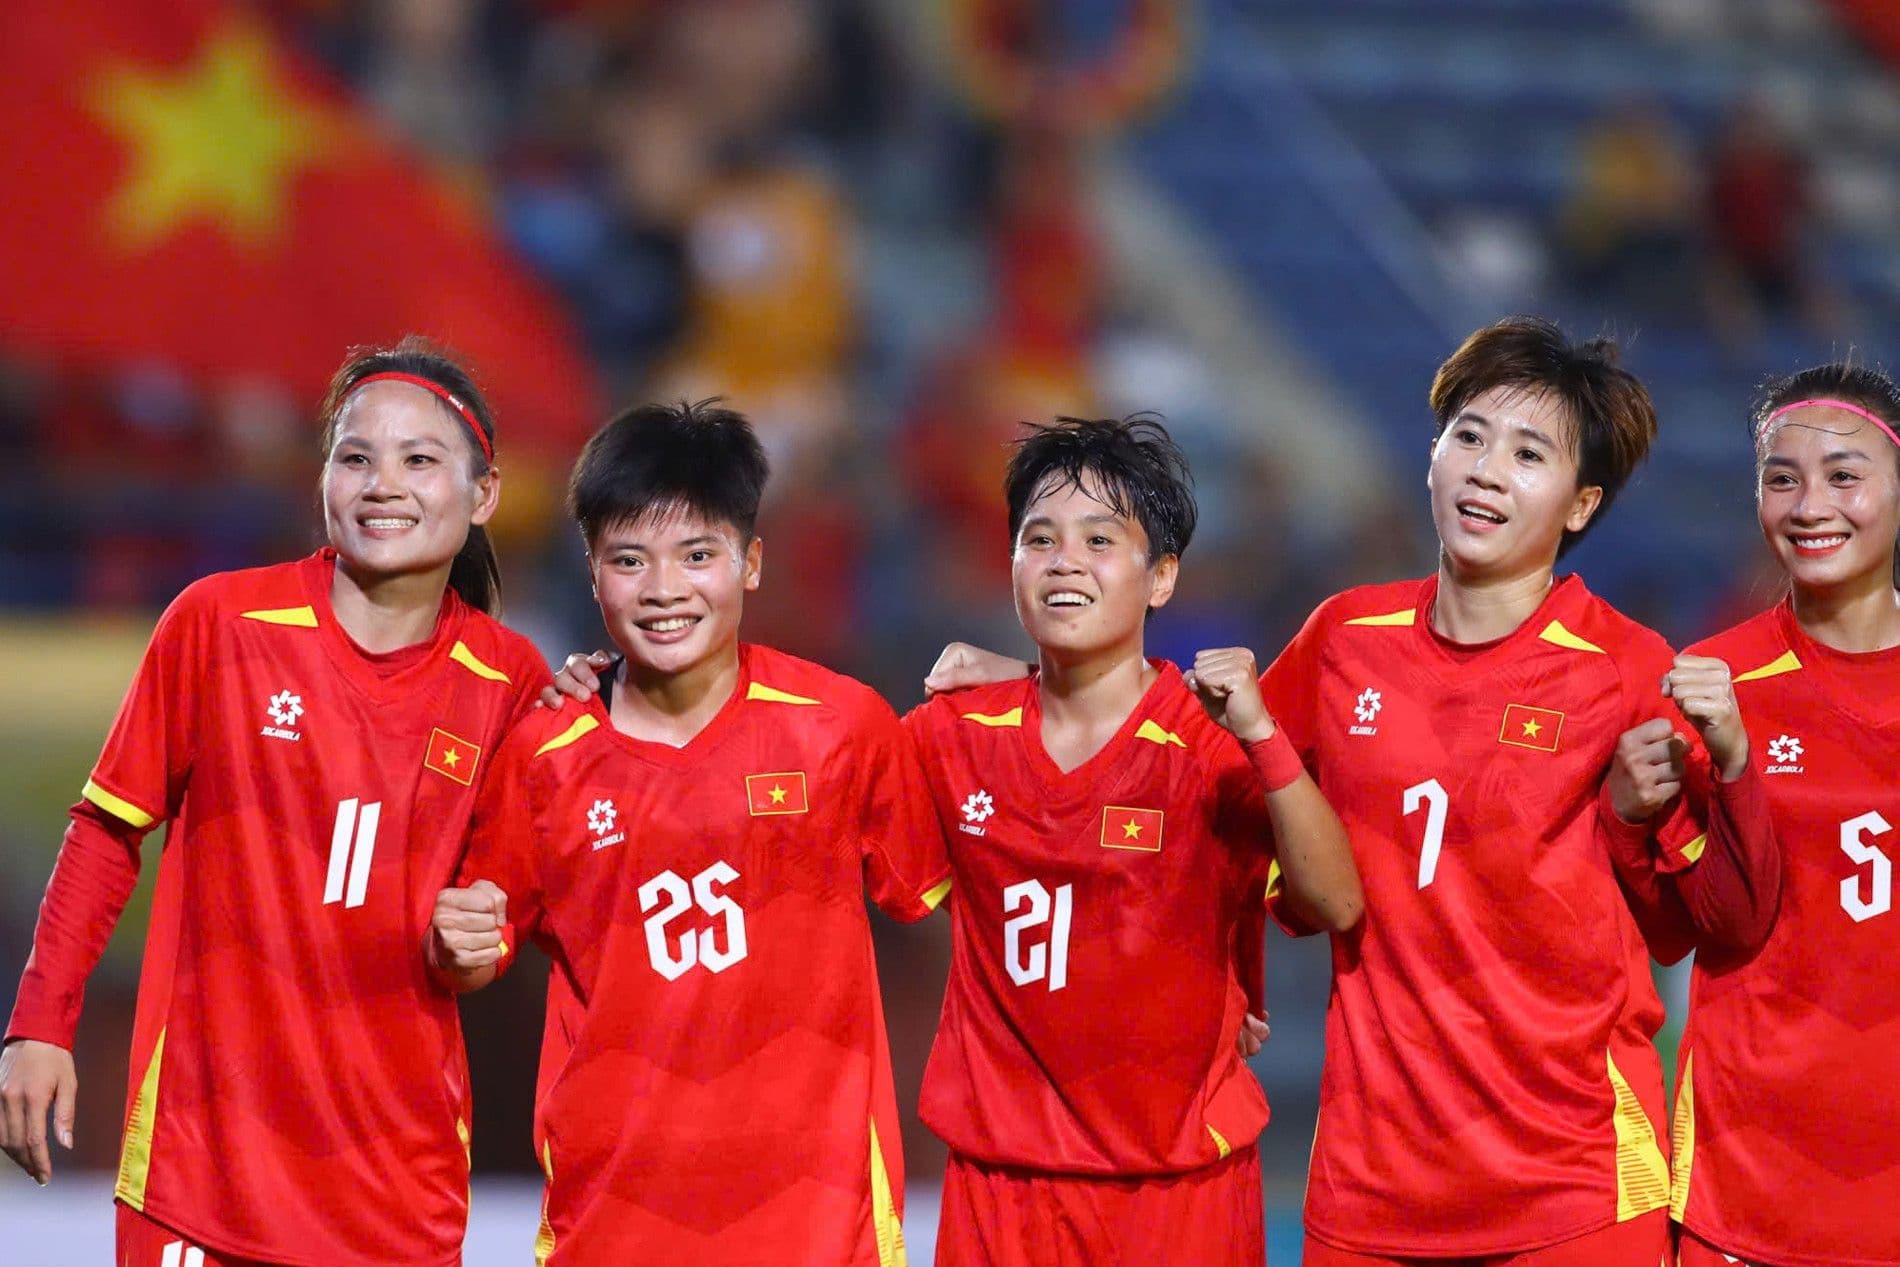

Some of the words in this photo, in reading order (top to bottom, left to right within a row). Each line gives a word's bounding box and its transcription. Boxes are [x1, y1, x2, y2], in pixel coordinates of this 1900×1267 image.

[323, 798, 381, 909] 11
[1402, 778, 1449, 890] 7
[1840, 810, 1893, 923] 5
[637, 860, 748, 982] 25
[1003, 878, 1073, 992] 21
